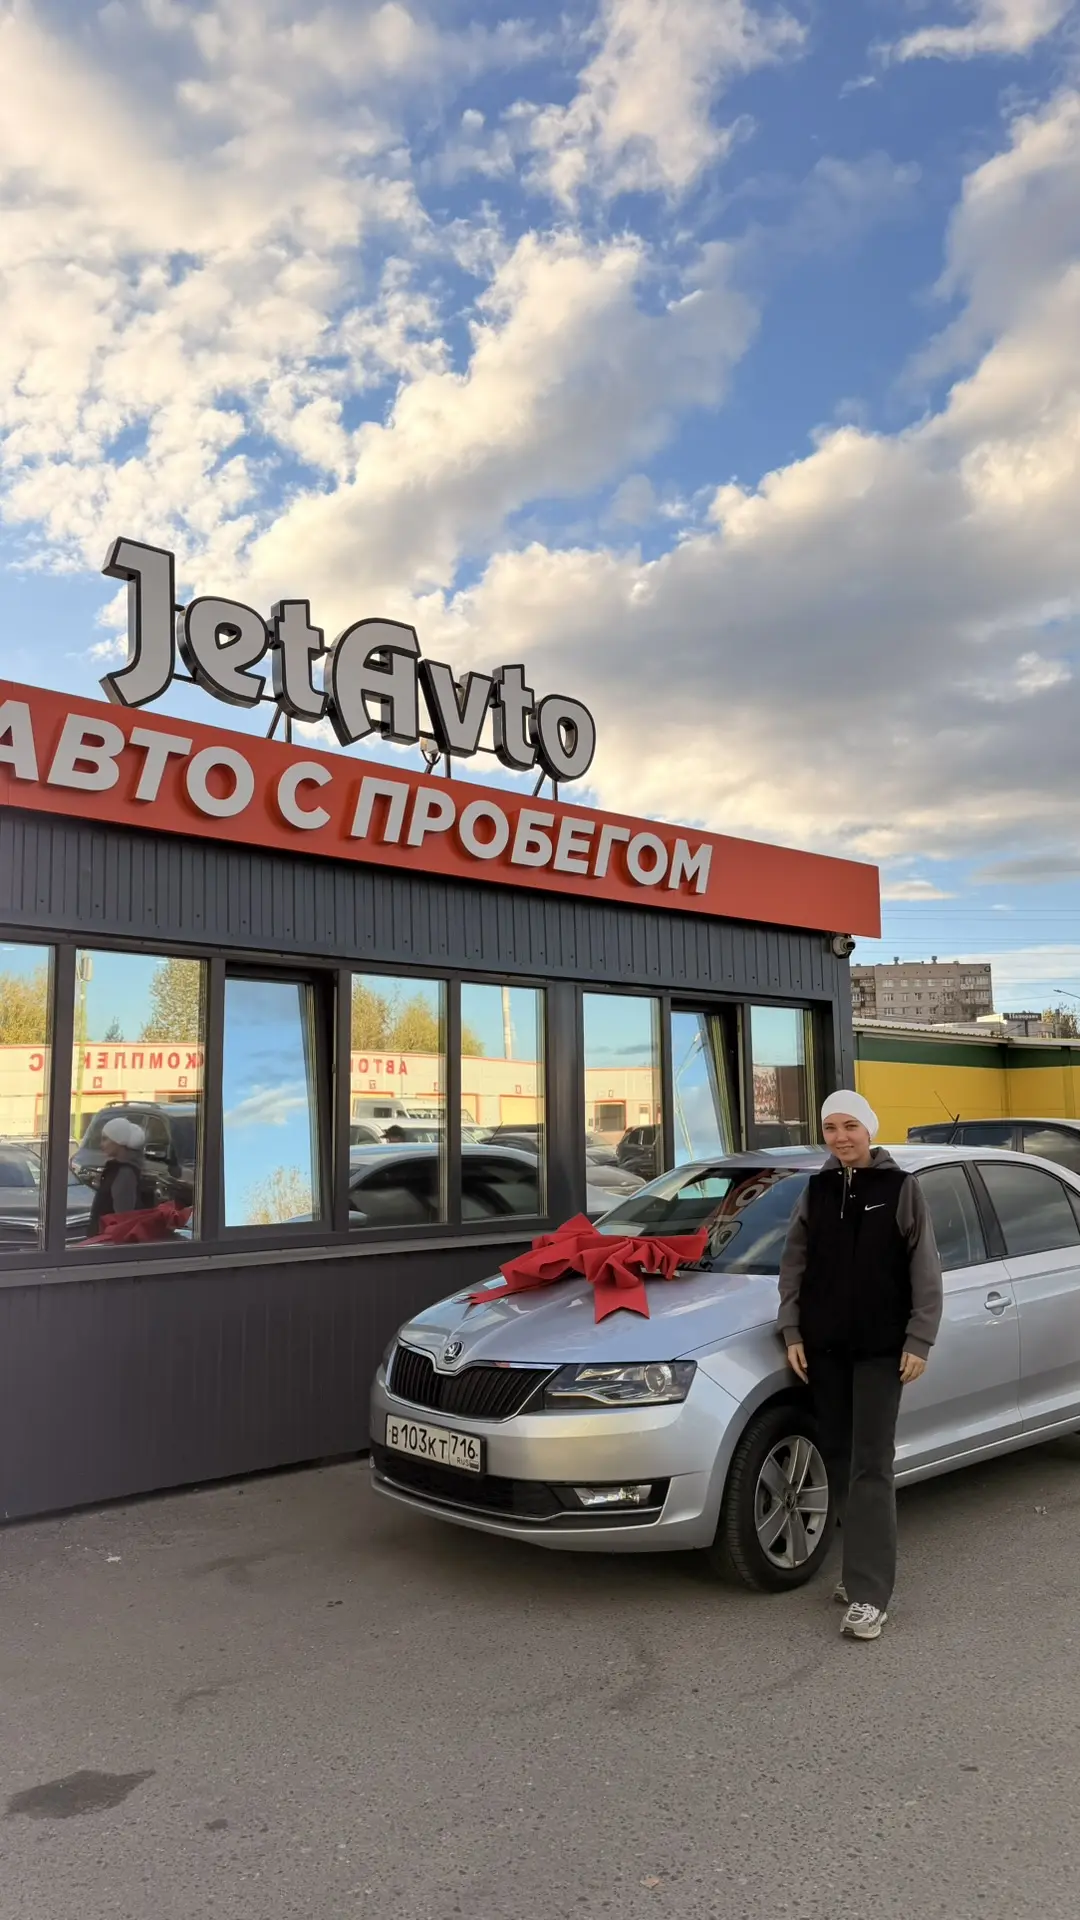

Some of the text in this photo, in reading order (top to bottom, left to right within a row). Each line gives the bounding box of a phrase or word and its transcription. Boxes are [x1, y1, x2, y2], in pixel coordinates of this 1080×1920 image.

[99, 536, 597, 784] JetAvto
[0, 699, 713, 894] АВТО С ПРОБЕГОМ
[451, 1435, 476, 1459] 716
[456, 1456, 470, 1467] RUS
